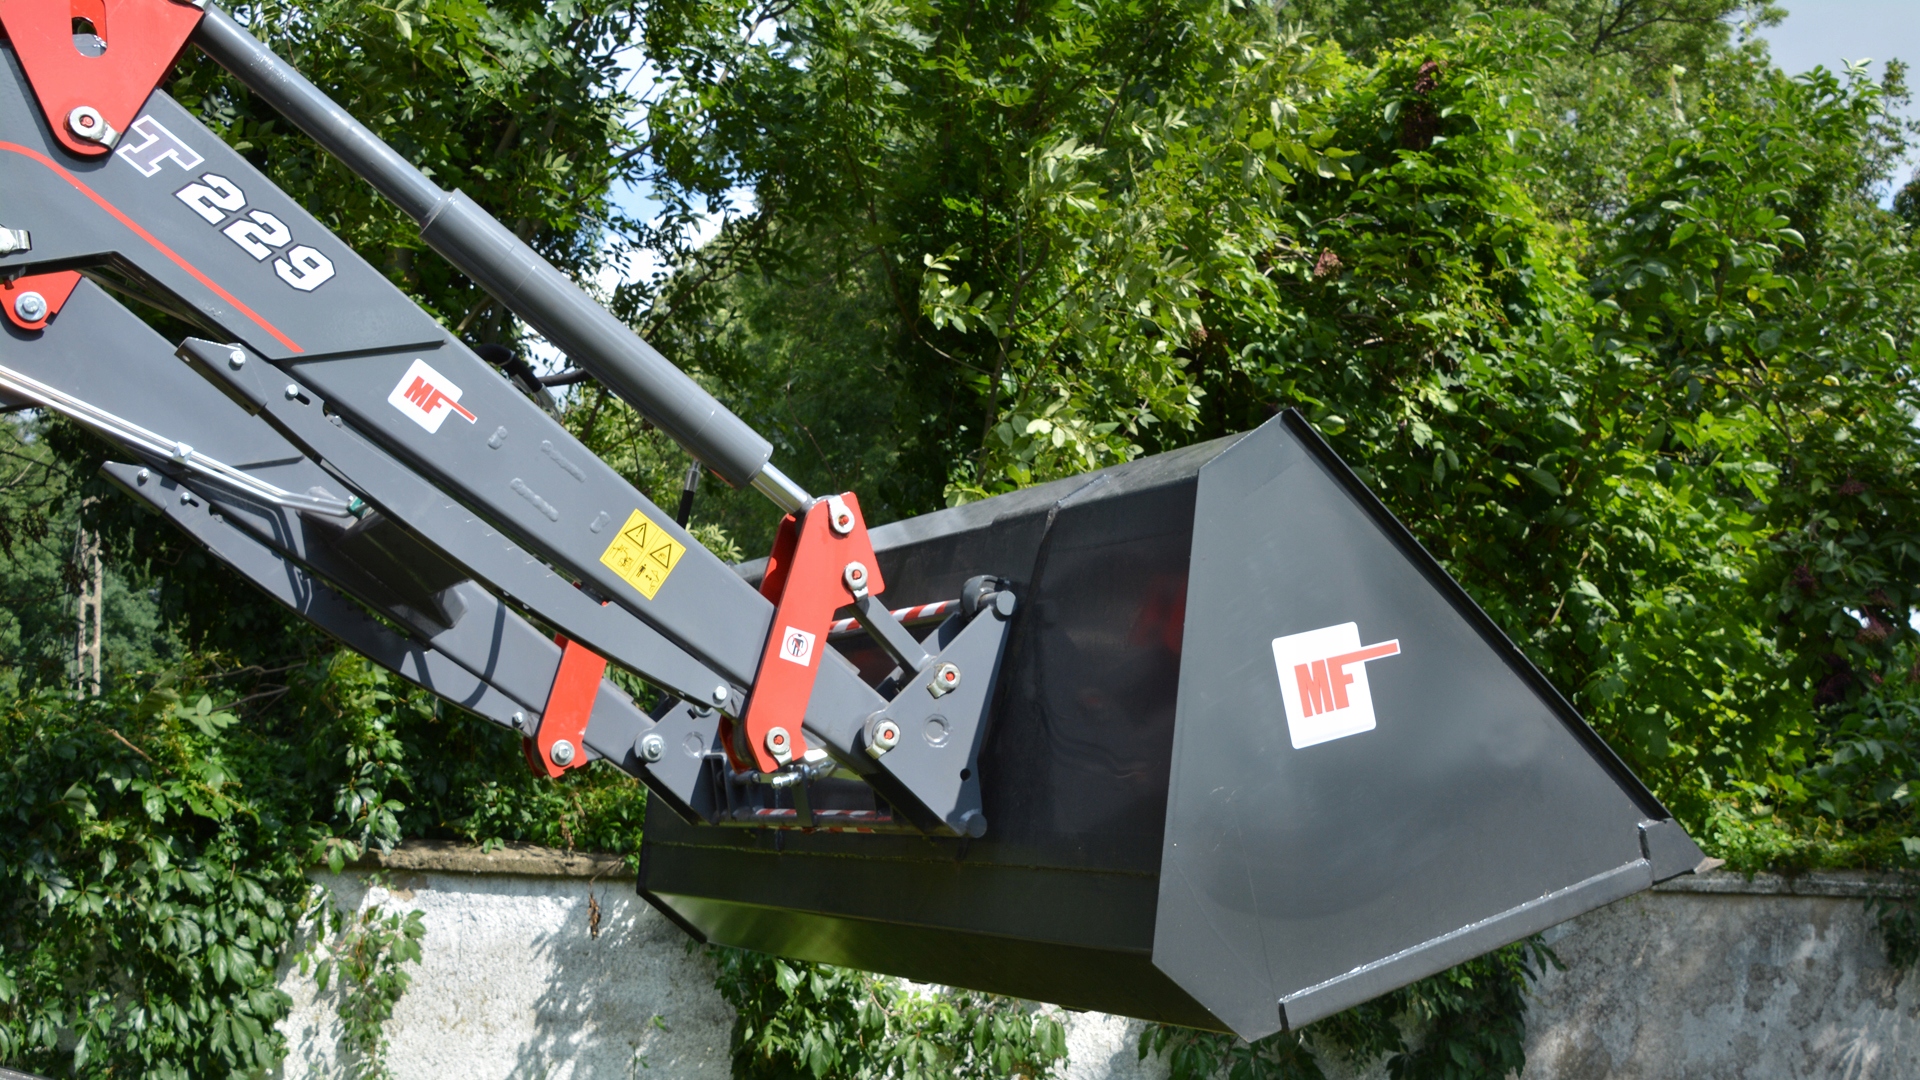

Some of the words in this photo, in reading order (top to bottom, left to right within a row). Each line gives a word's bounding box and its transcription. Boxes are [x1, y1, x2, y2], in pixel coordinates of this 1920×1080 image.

[116, 115, 204, 177] T
[173, 173, 336, 292] 229
[404, 376, 475, 420] MF
[1295, 642, 1398, 718] MF
